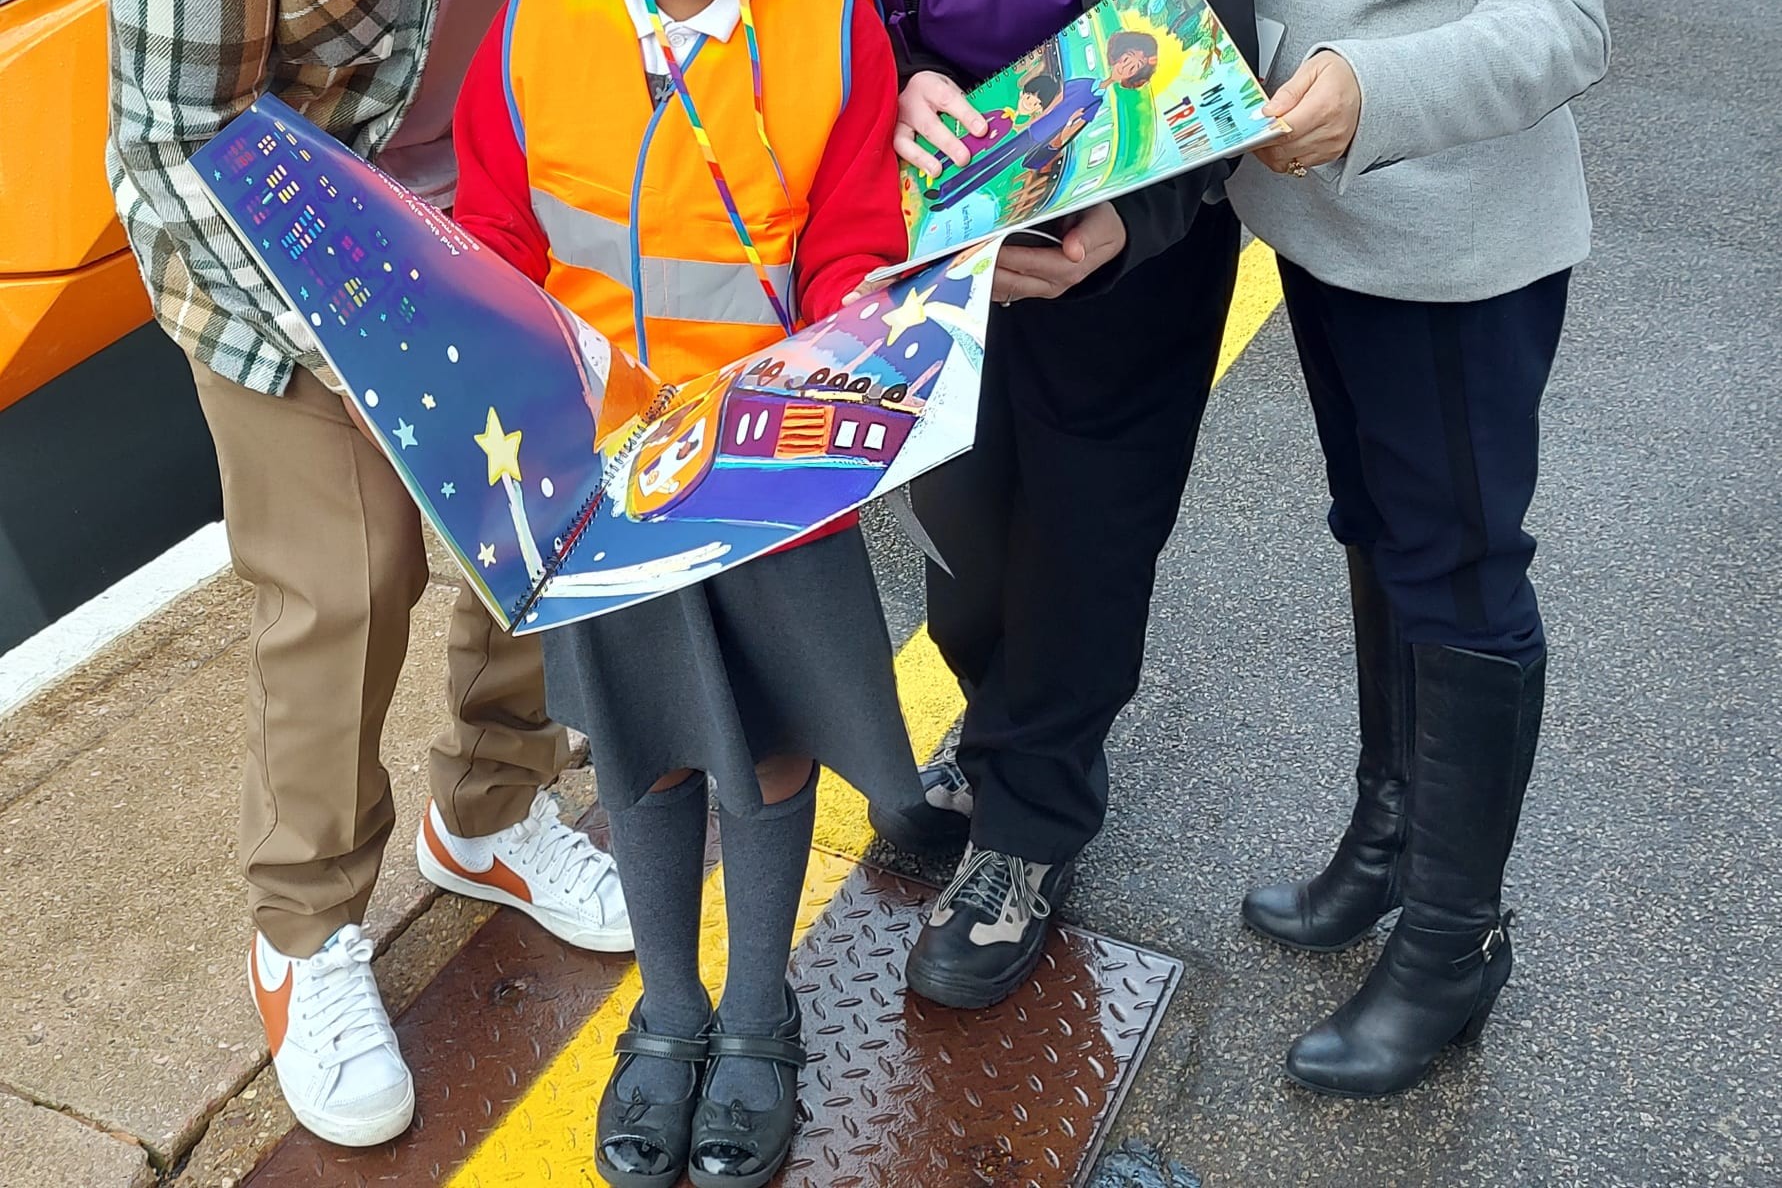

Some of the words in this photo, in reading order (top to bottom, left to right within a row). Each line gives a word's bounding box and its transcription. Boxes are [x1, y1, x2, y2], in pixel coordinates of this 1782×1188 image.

[1199, 83, 1225, 108] My
[1163, 96, 1205, 144] TRAIN
[425, 218, 440, 236] the
[440, 236, 460, 255] And
